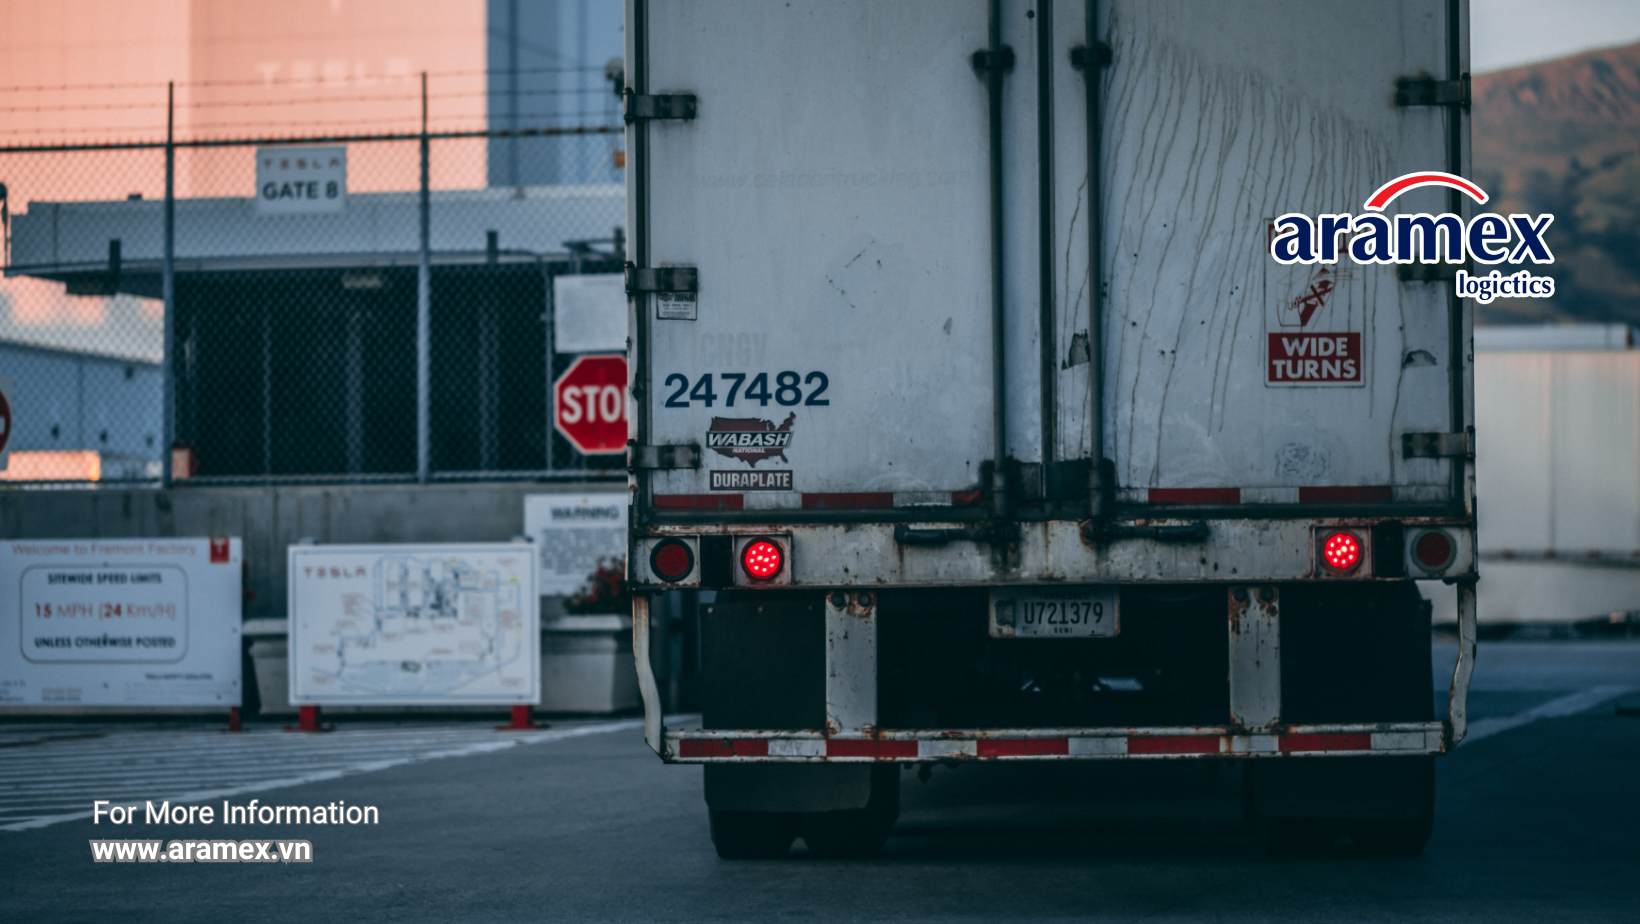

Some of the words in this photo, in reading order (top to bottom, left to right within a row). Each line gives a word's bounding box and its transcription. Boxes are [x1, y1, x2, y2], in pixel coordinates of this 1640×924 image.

[255, 57, 412, 89] TESLA
[263, 156, 341, 171] TESLA
[262, 180, 319, 201] GATE
[325, 180, 339, 200] 8
[1281, 337, 1348, 357] WIDE
[1272, 359, 1357, 380] TURNS
[664, 370, 830, 408] 247482
[561, 385, 628, 424] STO
[708, 433, 790, 447] WABASH
[713, 473, 790, 488] DURAPLATE
[12, 542, 71, 556] Welcome
[75, 542, 88, 555] to
[91, 541, 144, 555] Fremont
[148, 541, 197, 557] Factory
[47, 572, 94, 585] SITEWIDE
[97, 572, 128, 585] SPEED
[131, 572, 163, 585] LIMITS
[304, 566, 367, 579] TESLA
[35, 603, 52, 619] 15
[57, 603, 93, 619] MPH
[1023, 601, 1104, 625] U721379
[34, 636, 72, 649] UNLESS
[75, 635, 133, 649] OTHERWISE
[136, 635, 176, 648] POSTED
